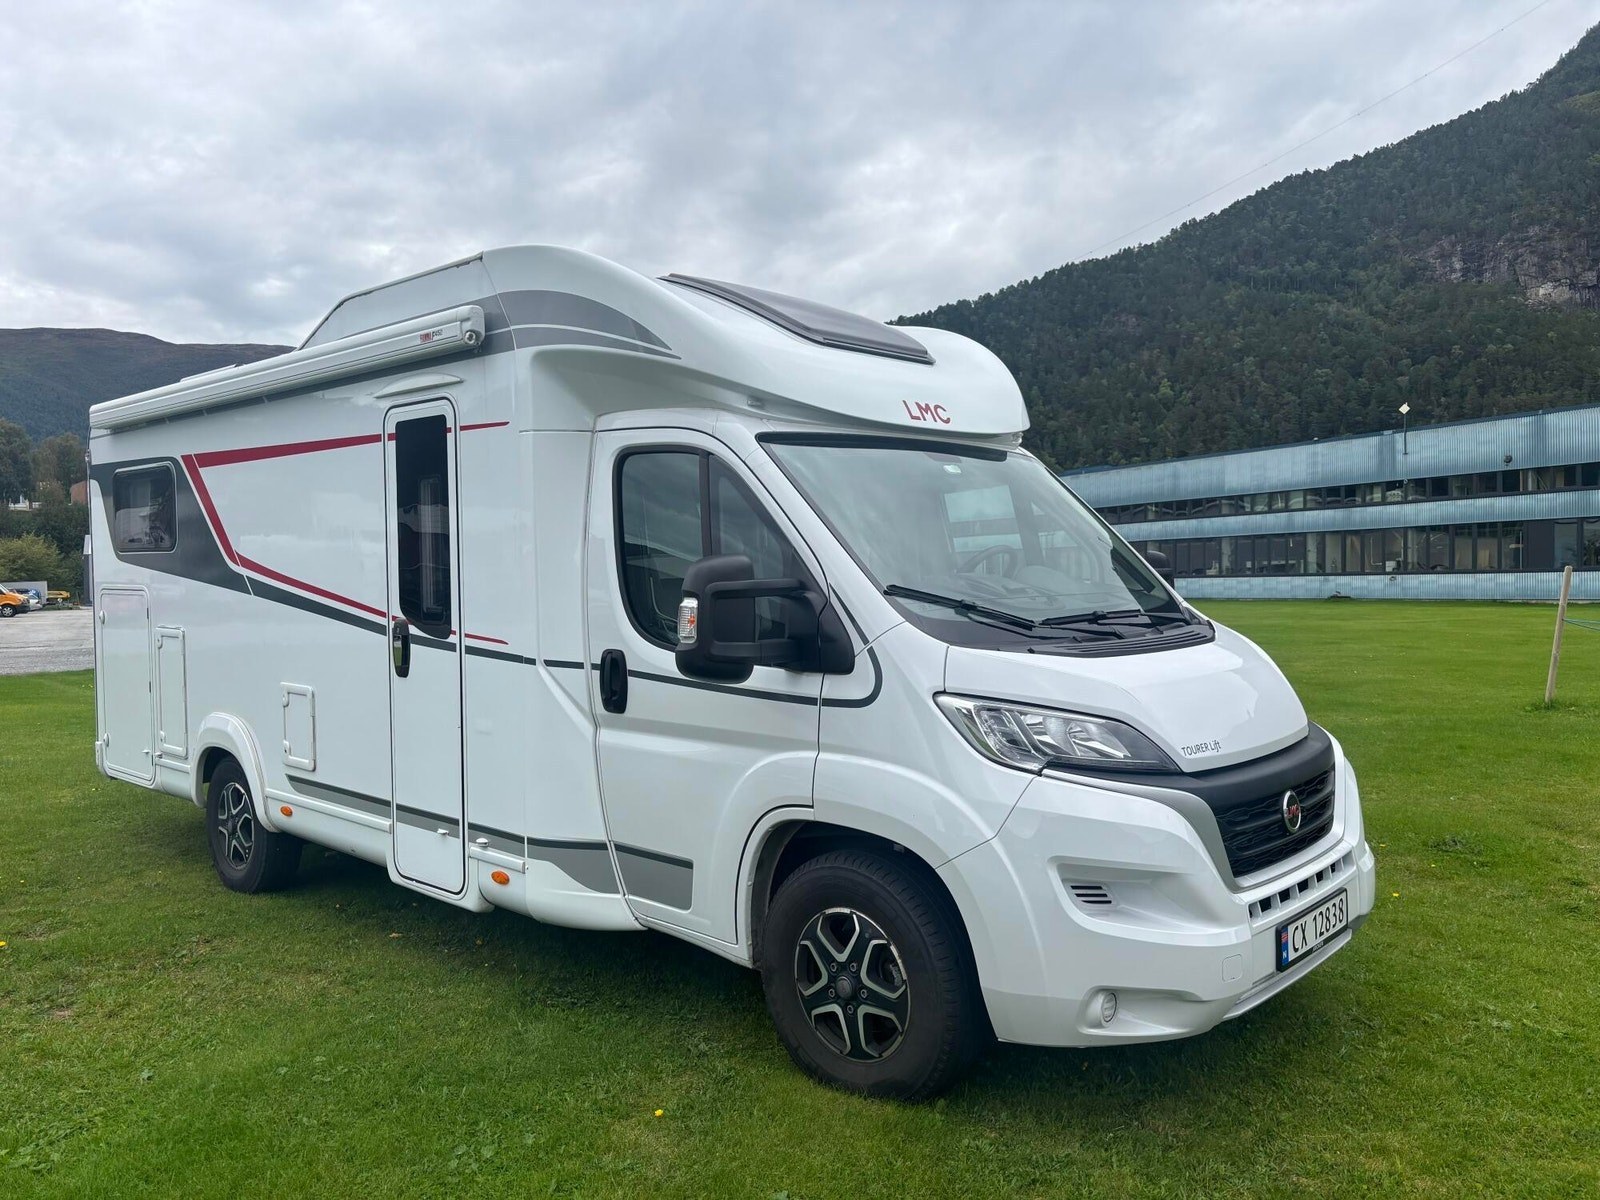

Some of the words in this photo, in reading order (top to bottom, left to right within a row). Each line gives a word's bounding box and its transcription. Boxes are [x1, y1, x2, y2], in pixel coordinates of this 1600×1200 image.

[902, 399, 951, 424] LMC
[1181, 742, 1210, 757] TOURER
[1209, 739, 1221, 753] Lift
[1292, 920, 1308, 953] CX
[1312, 897, 1344, 941] 12838
[1282, 950, 1287, 959] N
